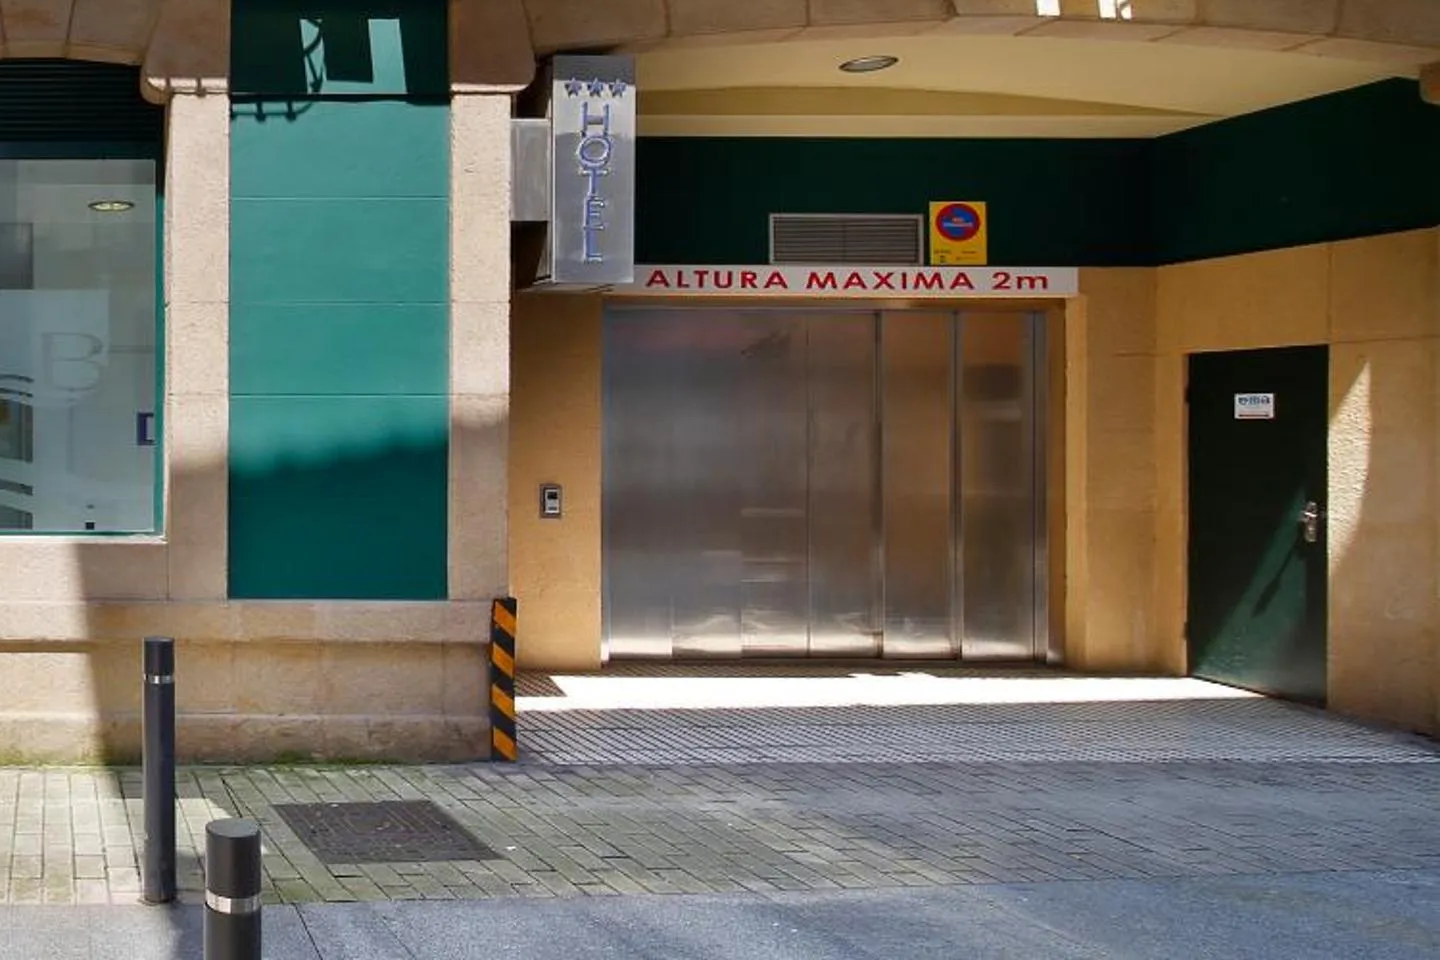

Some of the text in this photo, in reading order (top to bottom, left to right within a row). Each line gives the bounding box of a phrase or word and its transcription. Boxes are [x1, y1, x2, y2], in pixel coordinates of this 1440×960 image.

[578, 101, 610, 262] HOTEL
[645, 270, 1049, 290] ALTURA MAXIMA 2m
